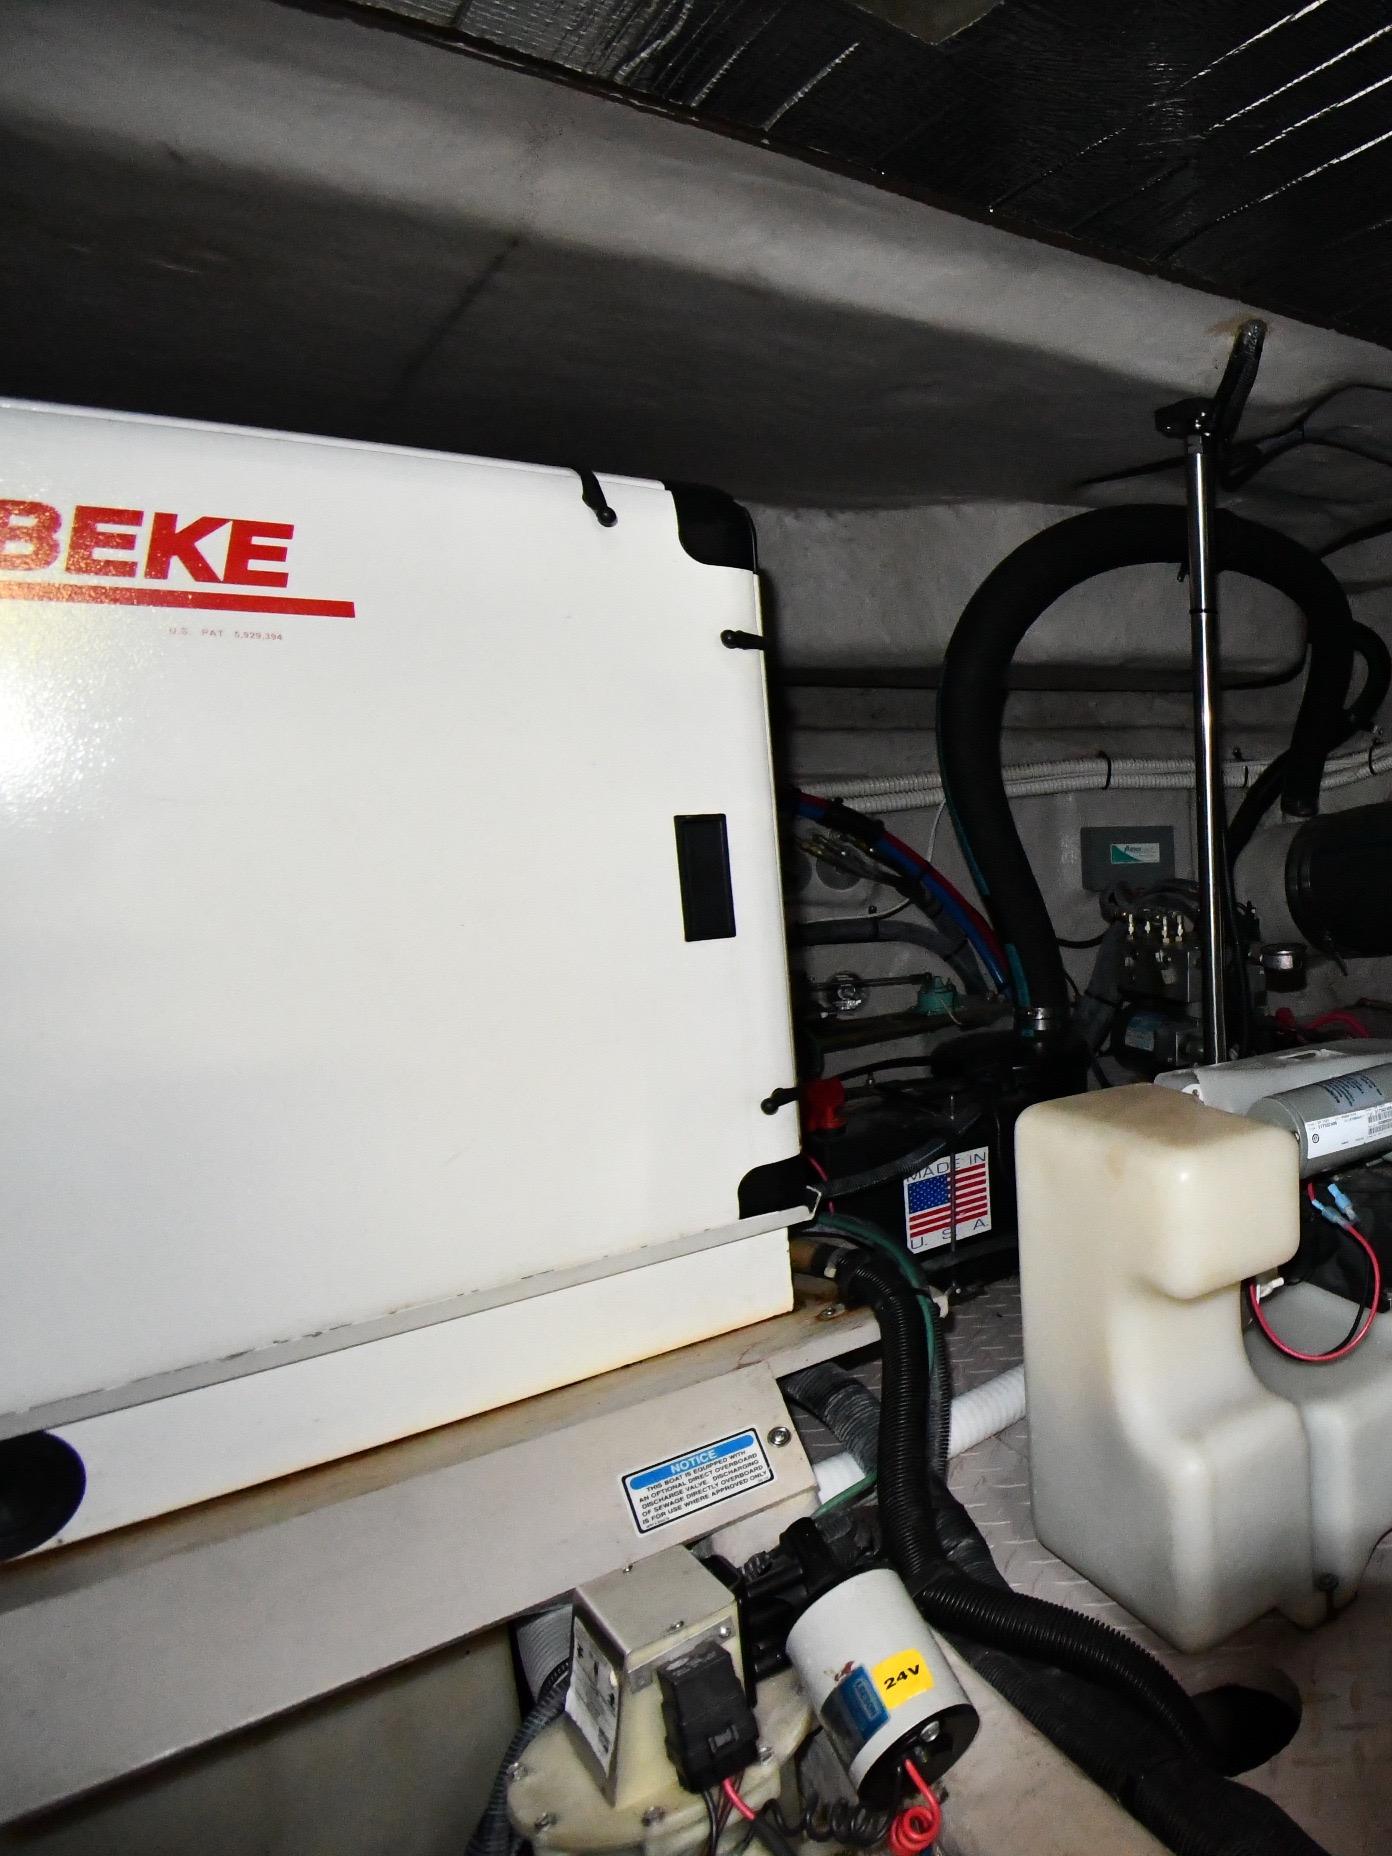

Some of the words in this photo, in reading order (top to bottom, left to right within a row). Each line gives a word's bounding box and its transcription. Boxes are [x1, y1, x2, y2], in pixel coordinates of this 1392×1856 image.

[0, 498, 295, 588] BEKE
[201, 629, 224, 638] PAT
[970, 1152, 986, 1165] IN
[647, 1483, 662, 1491] THIS
[664, 1475, 682, 1485] BOAT
[693, 1458, 727, 1474] EQUIPPED
[729, 1451, 745, 1459] WITH
[651, 1481, 686, 1498] OPTIONAL
[688, 1470, 712, 1483] DIRECT
[715, 1453, 757, 1473] OVERBOARD
[671, 1449, 717, 1474] NOTICE
[642, 1489, 684, 1509] DISCHARGE
[713, 1460, 759, 1481] DISCHARGING
[651, 1512, 666, 1520] FOR
[668, 1505, 682, 1514] USE
[684, 1495, 709, 1507] WHERE
[712, 1479, 748, 1496] APPROVED
[750, 1471, 766, 1480] ONLY
[654, 1496, 684, 1511] SEWAGE
[686, 1483, 718, 1499] DIRECTLY
[721, 1465, 763, 1485] OVERBOARD
[884, 1664, 920, 1690] 24V
